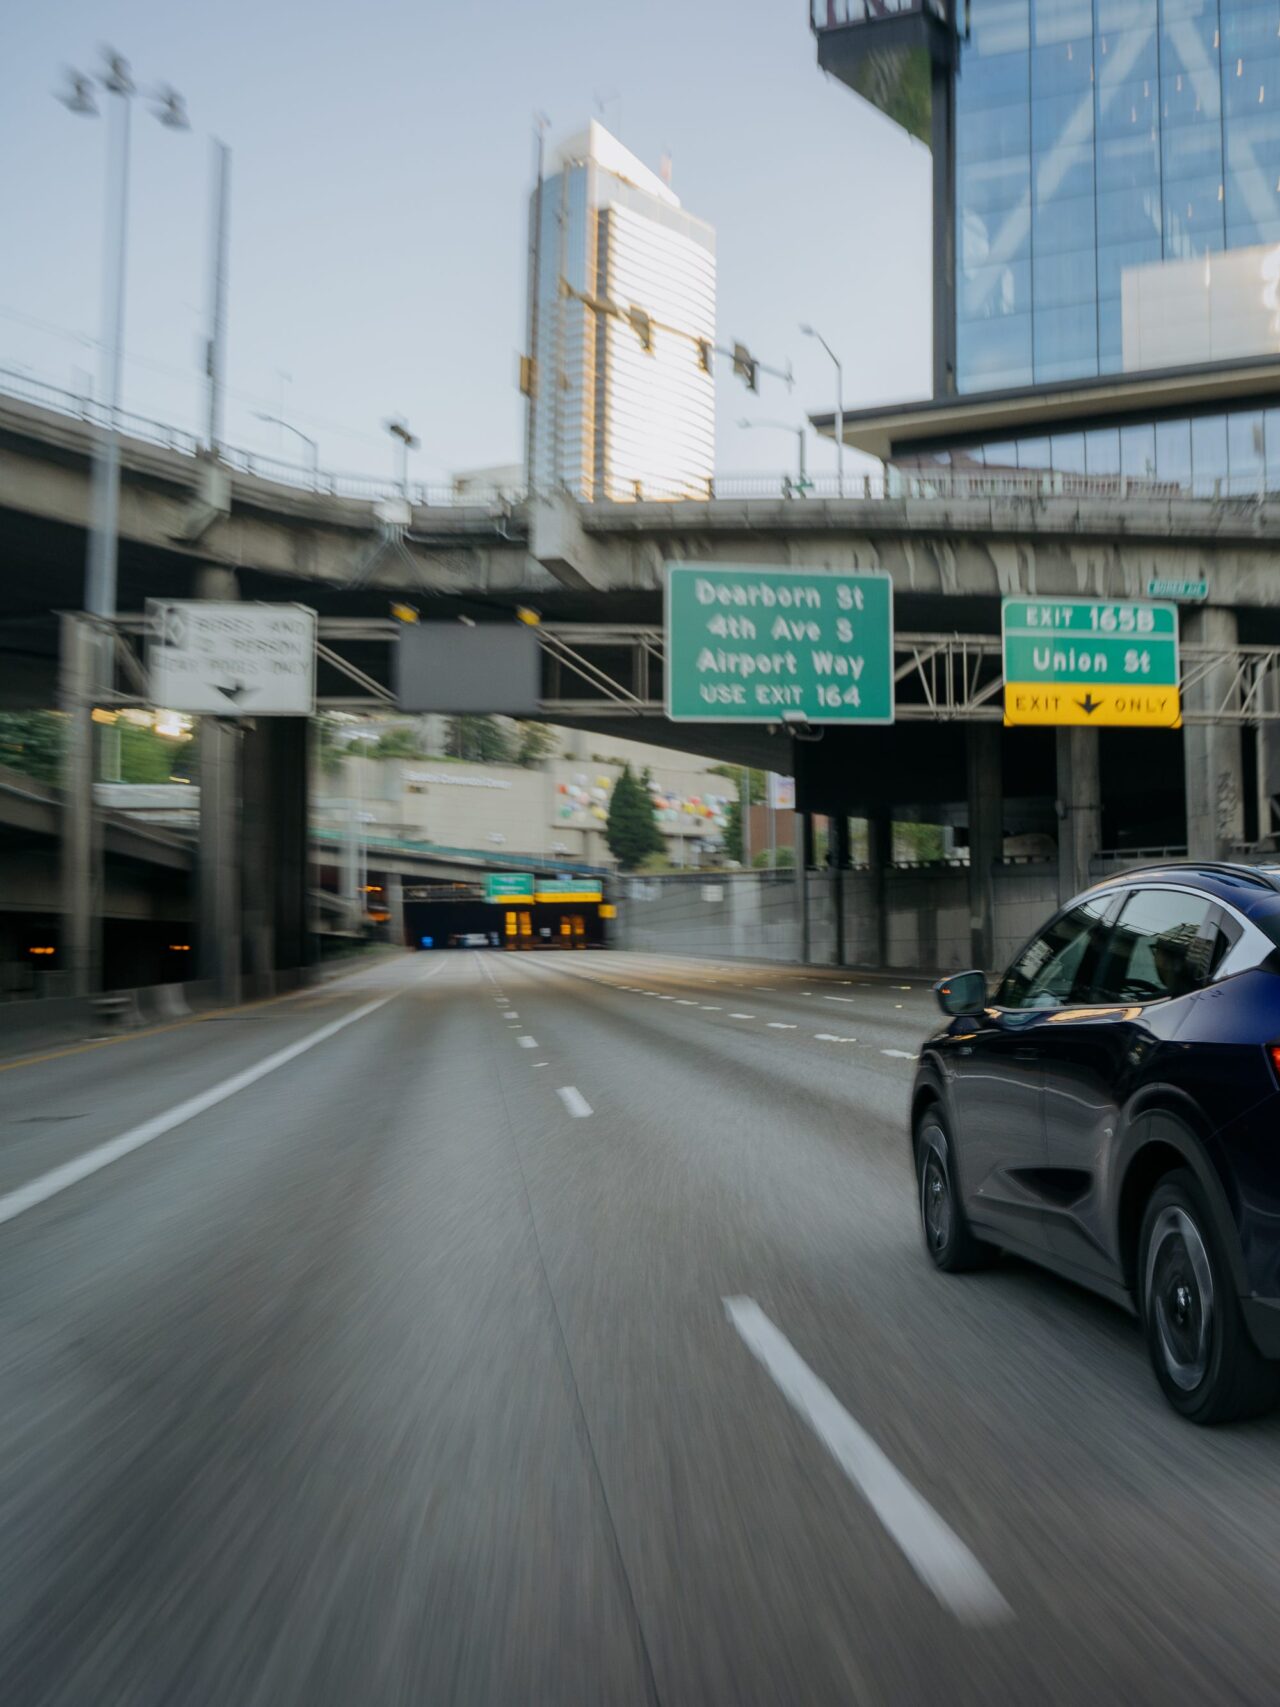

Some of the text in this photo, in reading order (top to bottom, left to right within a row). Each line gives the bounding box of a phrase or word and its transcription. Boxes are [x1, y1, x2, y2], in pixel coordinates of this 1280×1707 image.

[696, 579, 864, 610] Dearborn St
[707, 613, 853, 643] 4th Ave S
[1026, 606, 1155, 632] EXIT 165B
[696, 648, 865, 681] Airport Way
[1033, 647, 1150, 674] Union St
[700, 683, 861, 708] USE EXIT 164
[1015, 695, 1168, 714] EXIT ONLY
